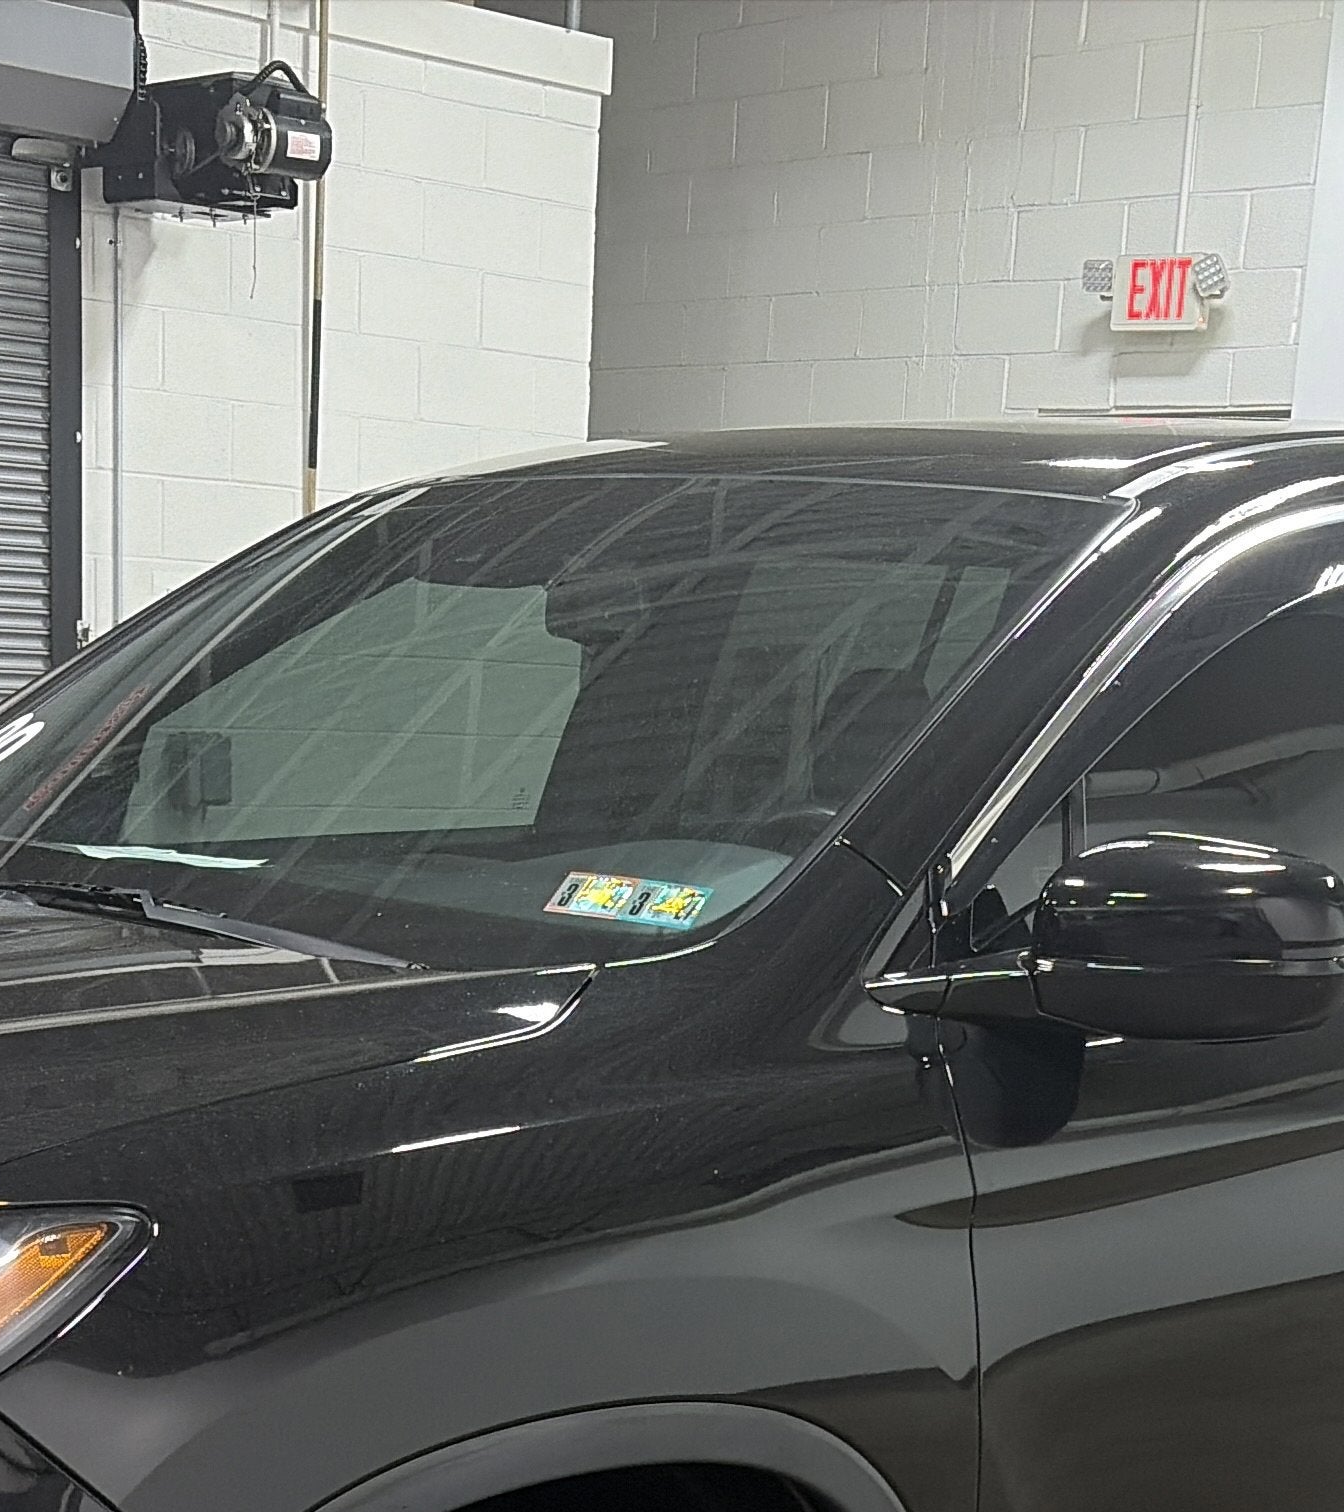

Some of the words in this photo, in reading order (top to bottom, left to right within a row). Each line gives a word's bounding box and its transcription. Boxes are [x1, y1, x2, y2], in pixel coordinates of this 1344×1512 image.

[1126, 257, 1193, 320] EXIT
[557, 883, 579, 907] 3
[628, 892, 652, 916] 3
